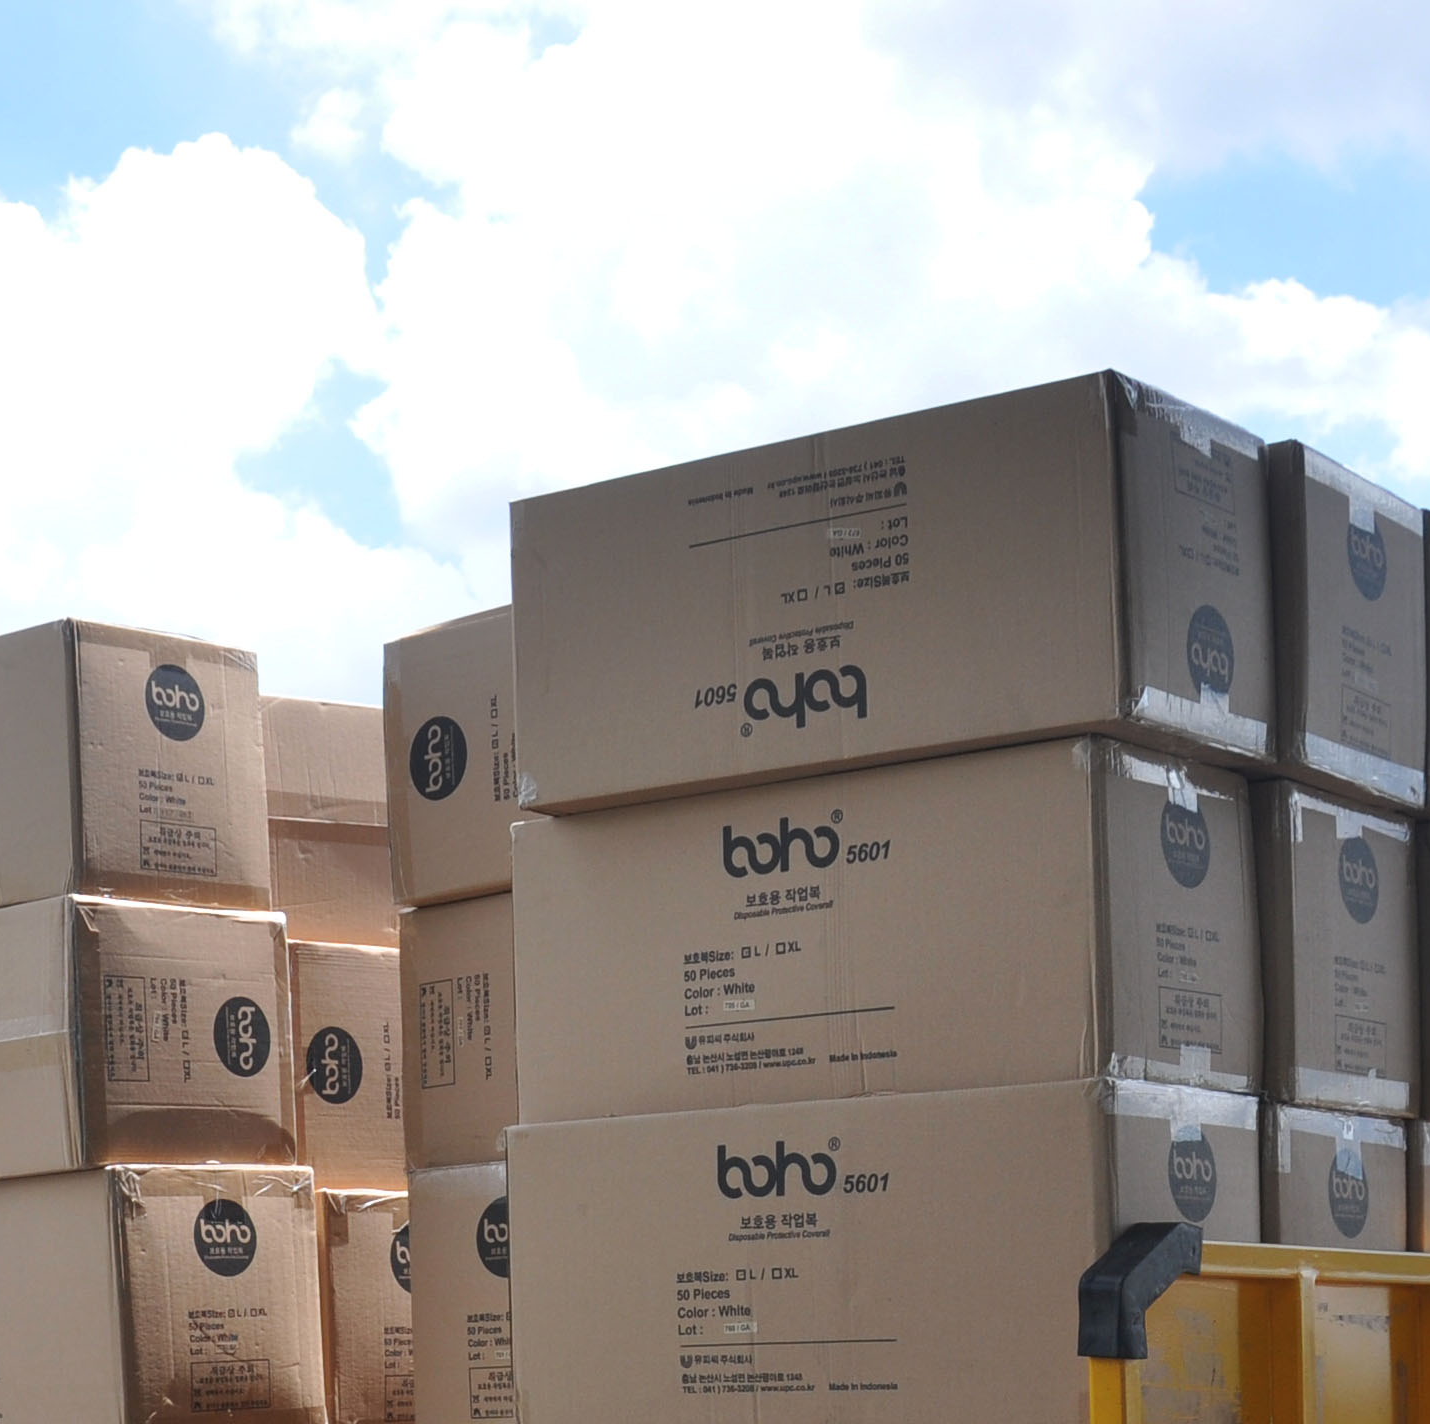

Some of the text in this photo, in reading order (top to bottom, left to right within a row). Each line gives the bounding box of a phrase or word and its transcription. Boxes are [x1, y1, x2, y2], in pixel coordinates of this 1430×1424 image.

[875, 534, 909, 549] Color
[829, 542, 865, 558] White
[851, 553, 909, 572] 50 Pieces
[694, 683, 738, 709] 5601
[846, 840, 891, 864] 5601
[746, 890, 781, 908] 보호용
[734, 900, 834, 921] Disposable Protective Coverall
[787, 941, 802, 953] XL
[683, 966, 736, 983] 50 Pieces
[684, 982, 755, 1000] Color White
[860, 1050, 897, 1061] Indonesia
[843, 1172, 890, 1194] 5601
[740, 1212, 818, 1230] 보호용 작업복
[728, 1229, 830, 1243] Disposable Protective Coverall
[784, 1268, 799, 1279] XL
[677, 1288, 731, 1301] 50 Pieces
[677, 1305, 751, 1319] Color White
[720, 1354, 753, 1364] 주식회사
[829, 1383, 849, 1391] Made
[860, 1382, 898, 1391] Indonesia
